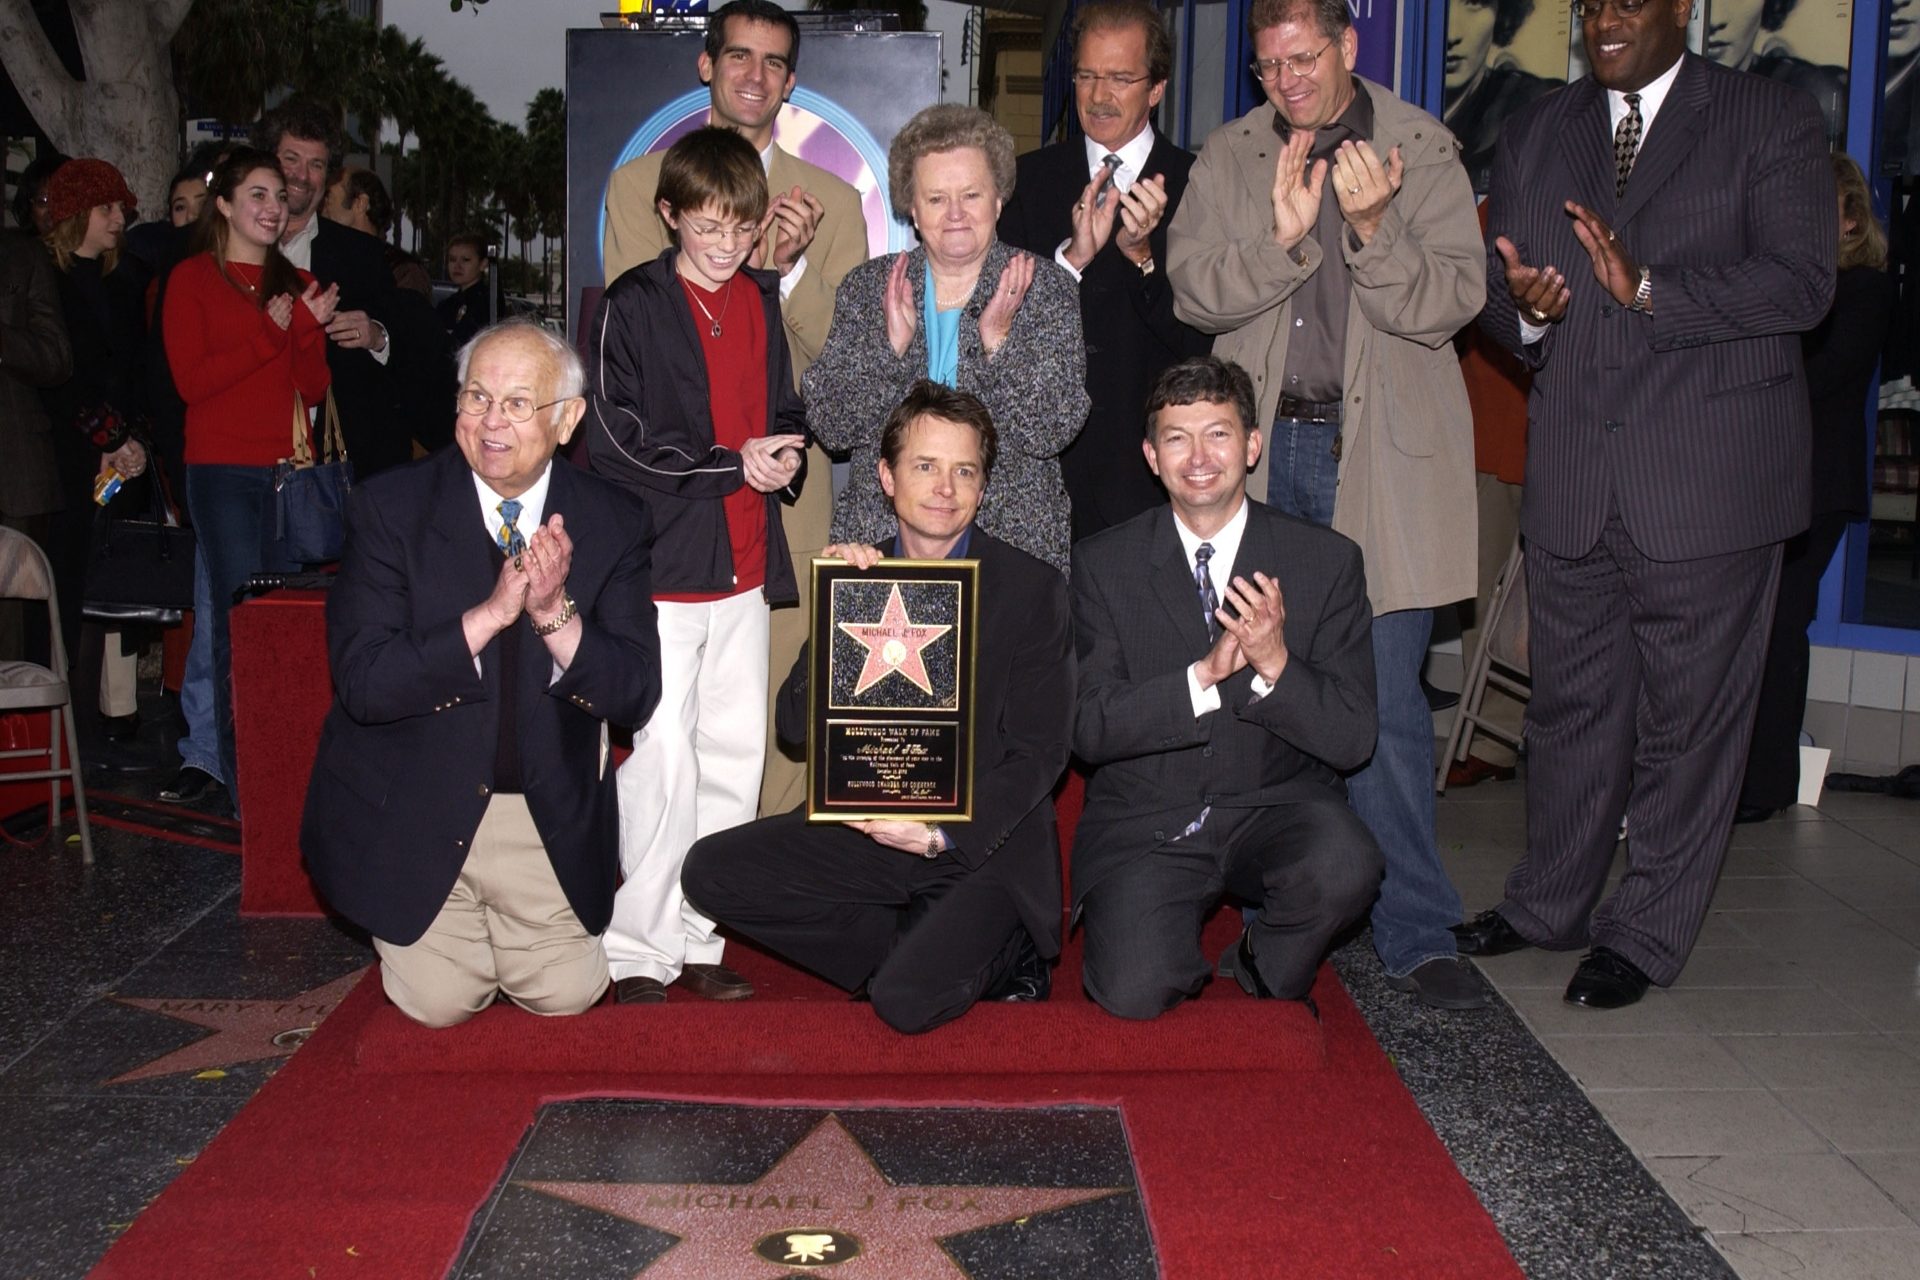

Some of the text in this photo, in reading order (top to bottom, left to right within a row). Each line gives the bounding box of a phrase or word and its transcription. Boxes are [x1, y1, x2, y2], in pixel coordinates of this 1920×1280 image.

[862, 628, 896, 638] MICHAEL
[911, 628, 927, 638] FOX
[845, 727, 941, 737] HOLLYWOOD WALK OF FAME
[857, 743, 900, 755] Michael
[847, 780, 876, 788] HOLLYWOOD
[901, 781, 909, 789] OF
[157, 1001, 253, 1013] MARY
[645, 1191, 982, 1212] MICHAEL J FOX
